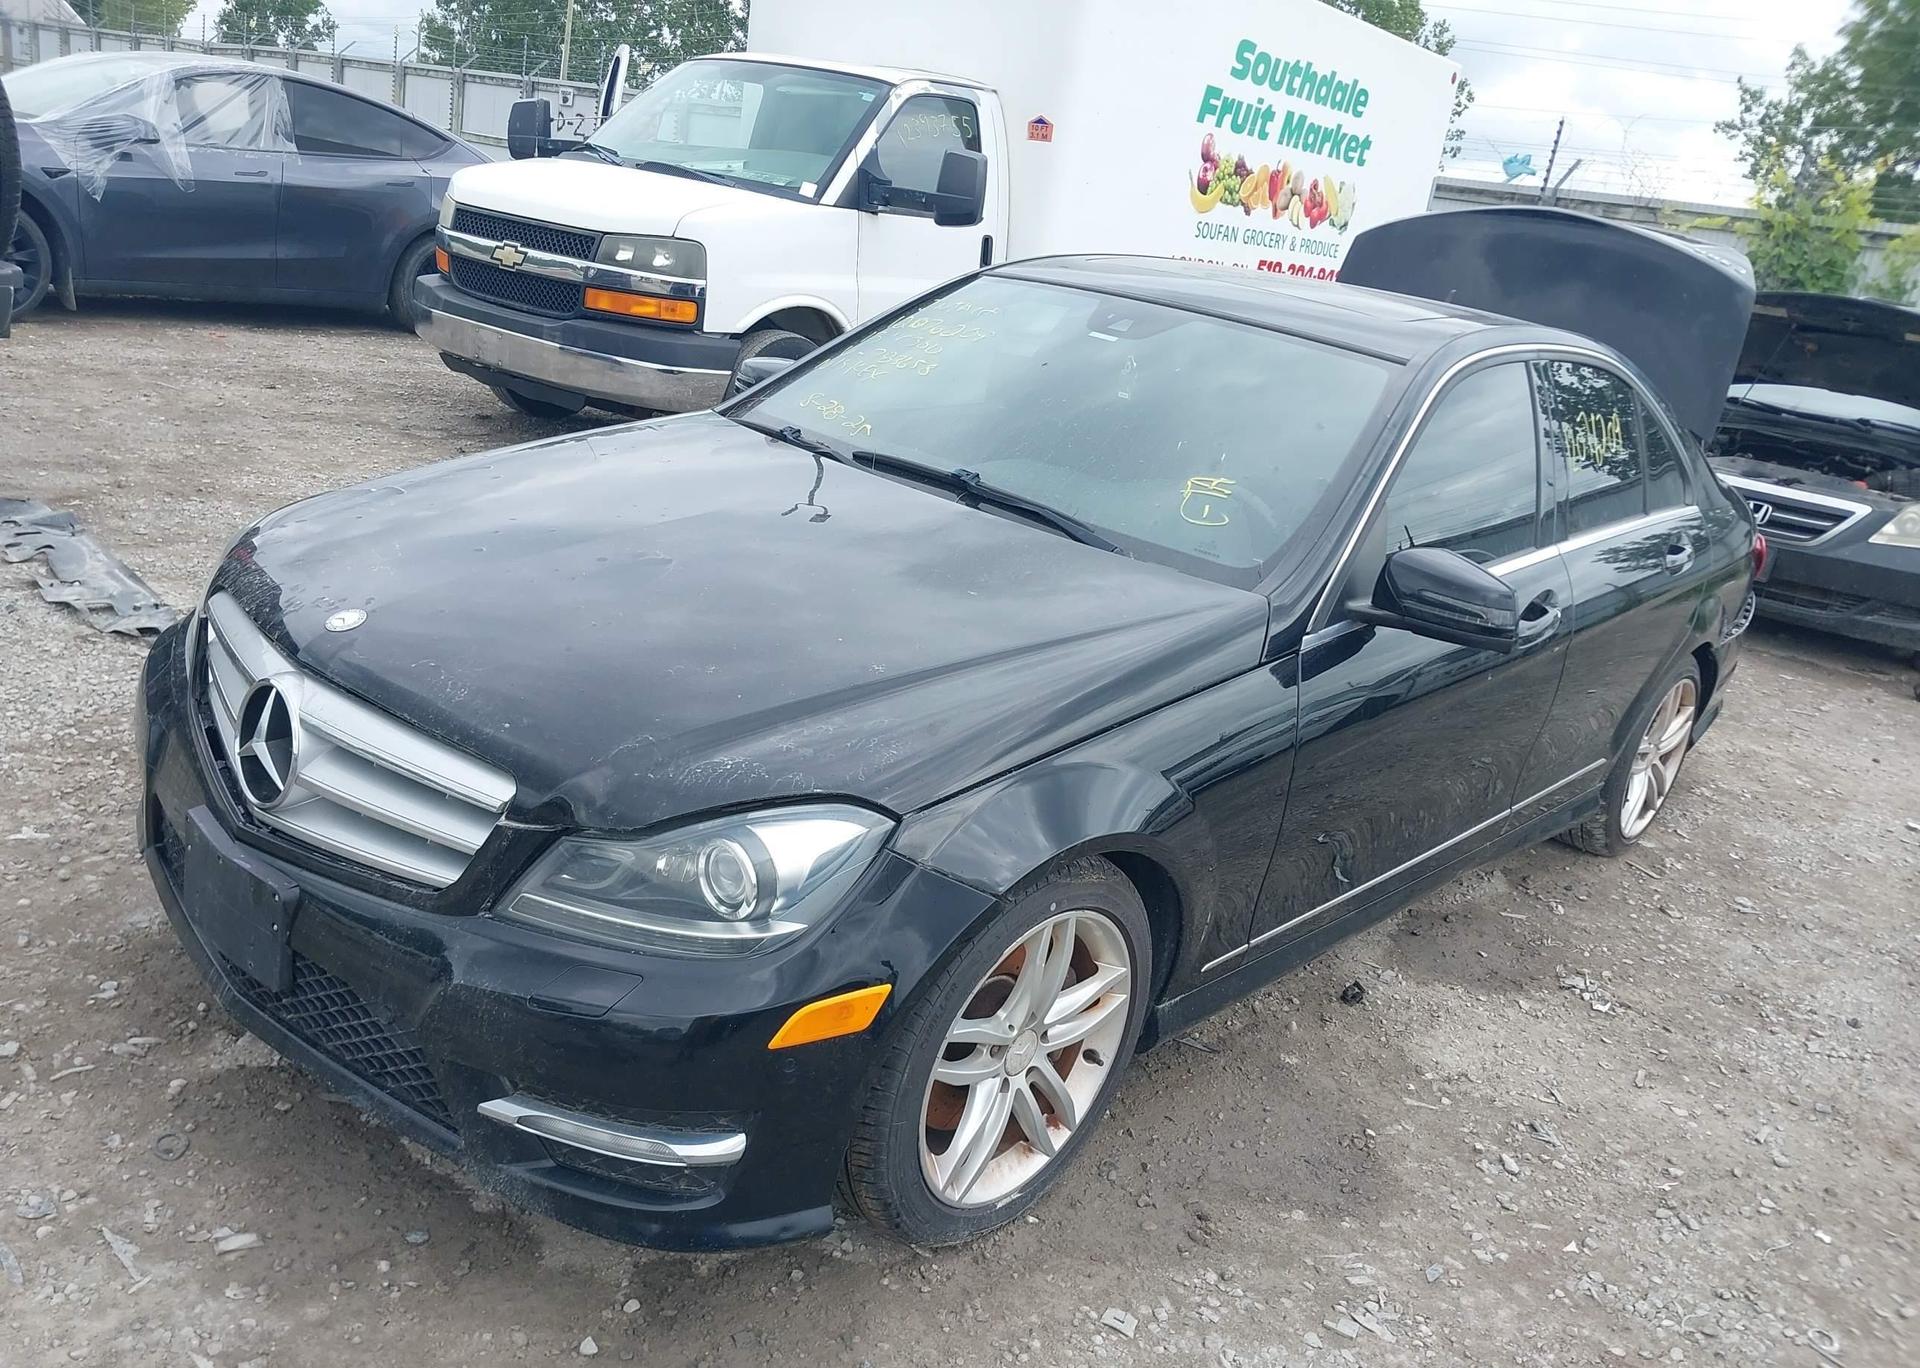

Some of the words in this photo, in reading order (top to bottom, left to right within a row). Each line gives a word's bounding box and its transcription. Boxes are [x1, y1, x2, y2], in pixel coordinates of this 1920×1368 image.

[1230, 38, 1369, 118] Southdale
[1196, 85, 1276, 141] Fruit
[1276, 110, 1372, 167] Market
[1194, 220, 1239, 243] SOUFAN
[1243, 228, 1287, 251] GROCERY
[1290, 236, 1297, 251] &
[1299, 237, 1340, 259] PRODUCE
